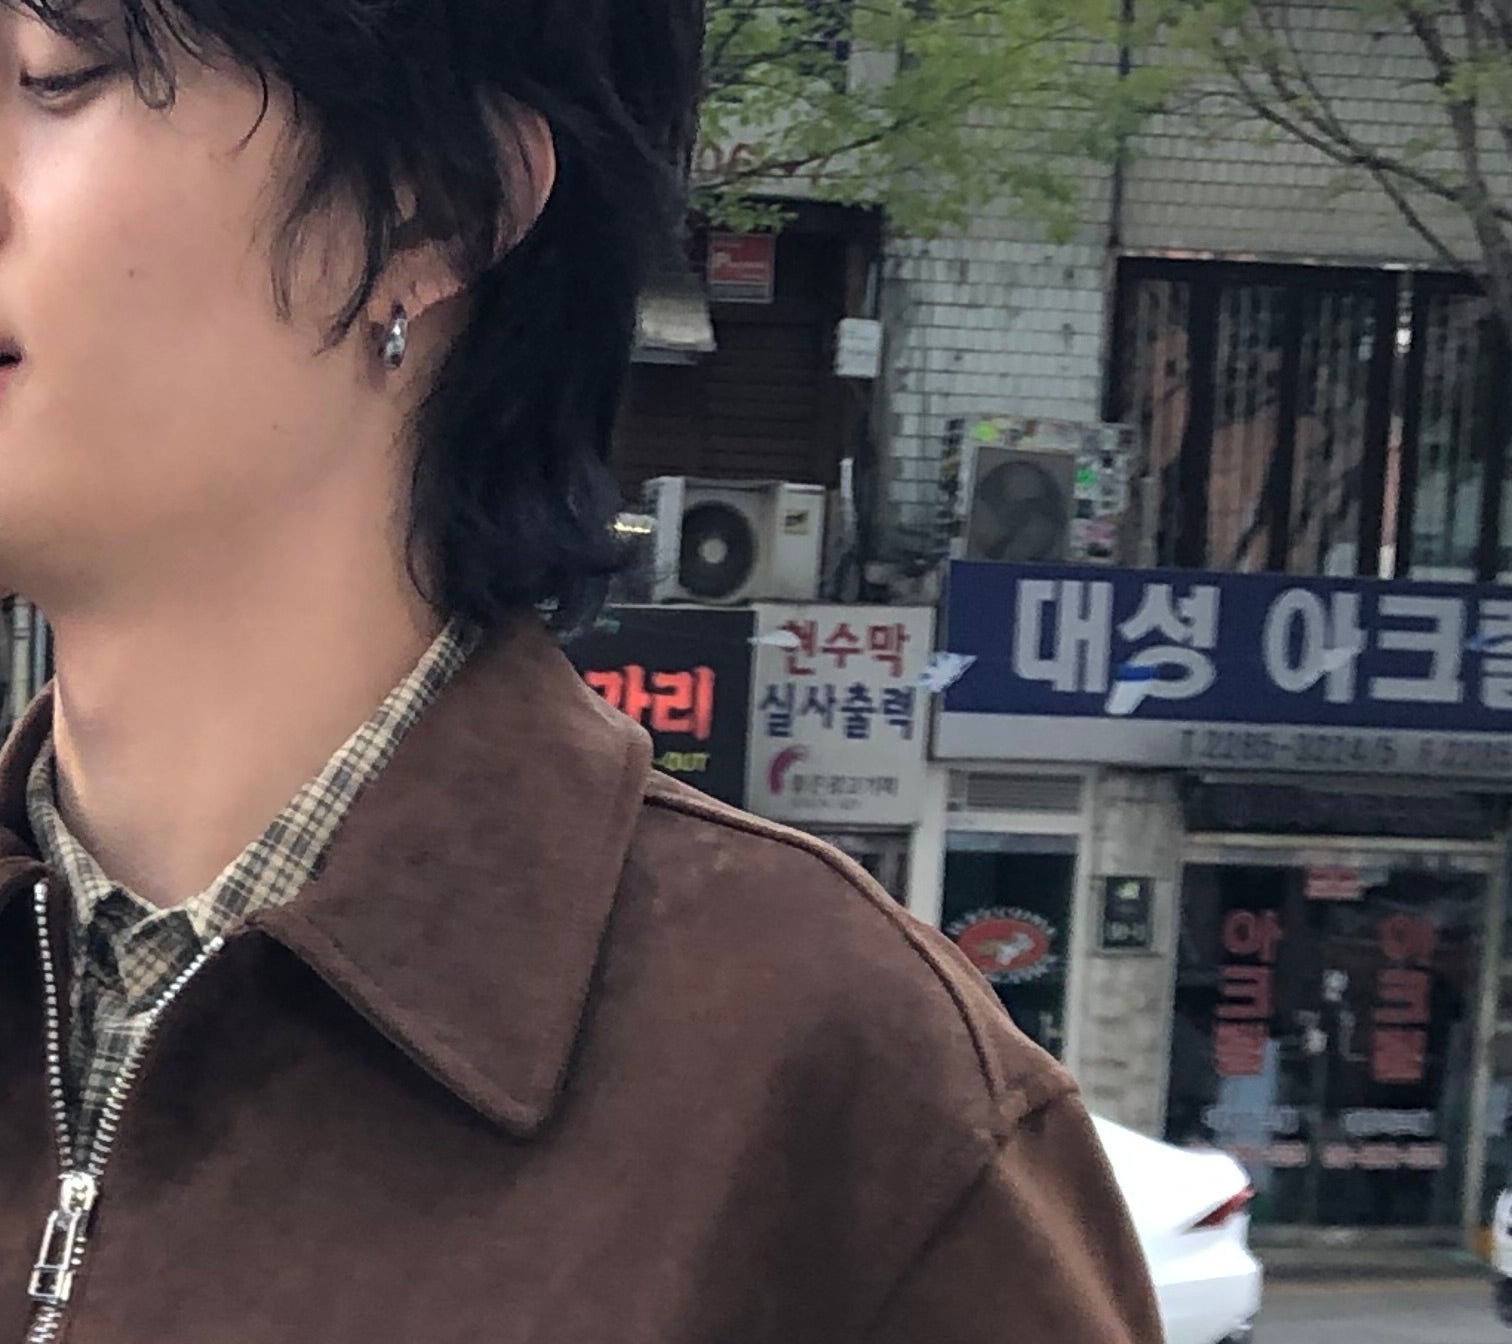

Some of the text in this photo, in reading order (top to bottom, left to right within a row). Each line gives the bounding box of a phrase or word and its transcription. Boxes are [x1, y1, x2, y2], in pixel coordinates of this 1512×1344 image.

[778, 620, 911, 677] 현수막
[1013, 579, 1221, 699] 대성
[758, 682, 916, 740] 실사출력
